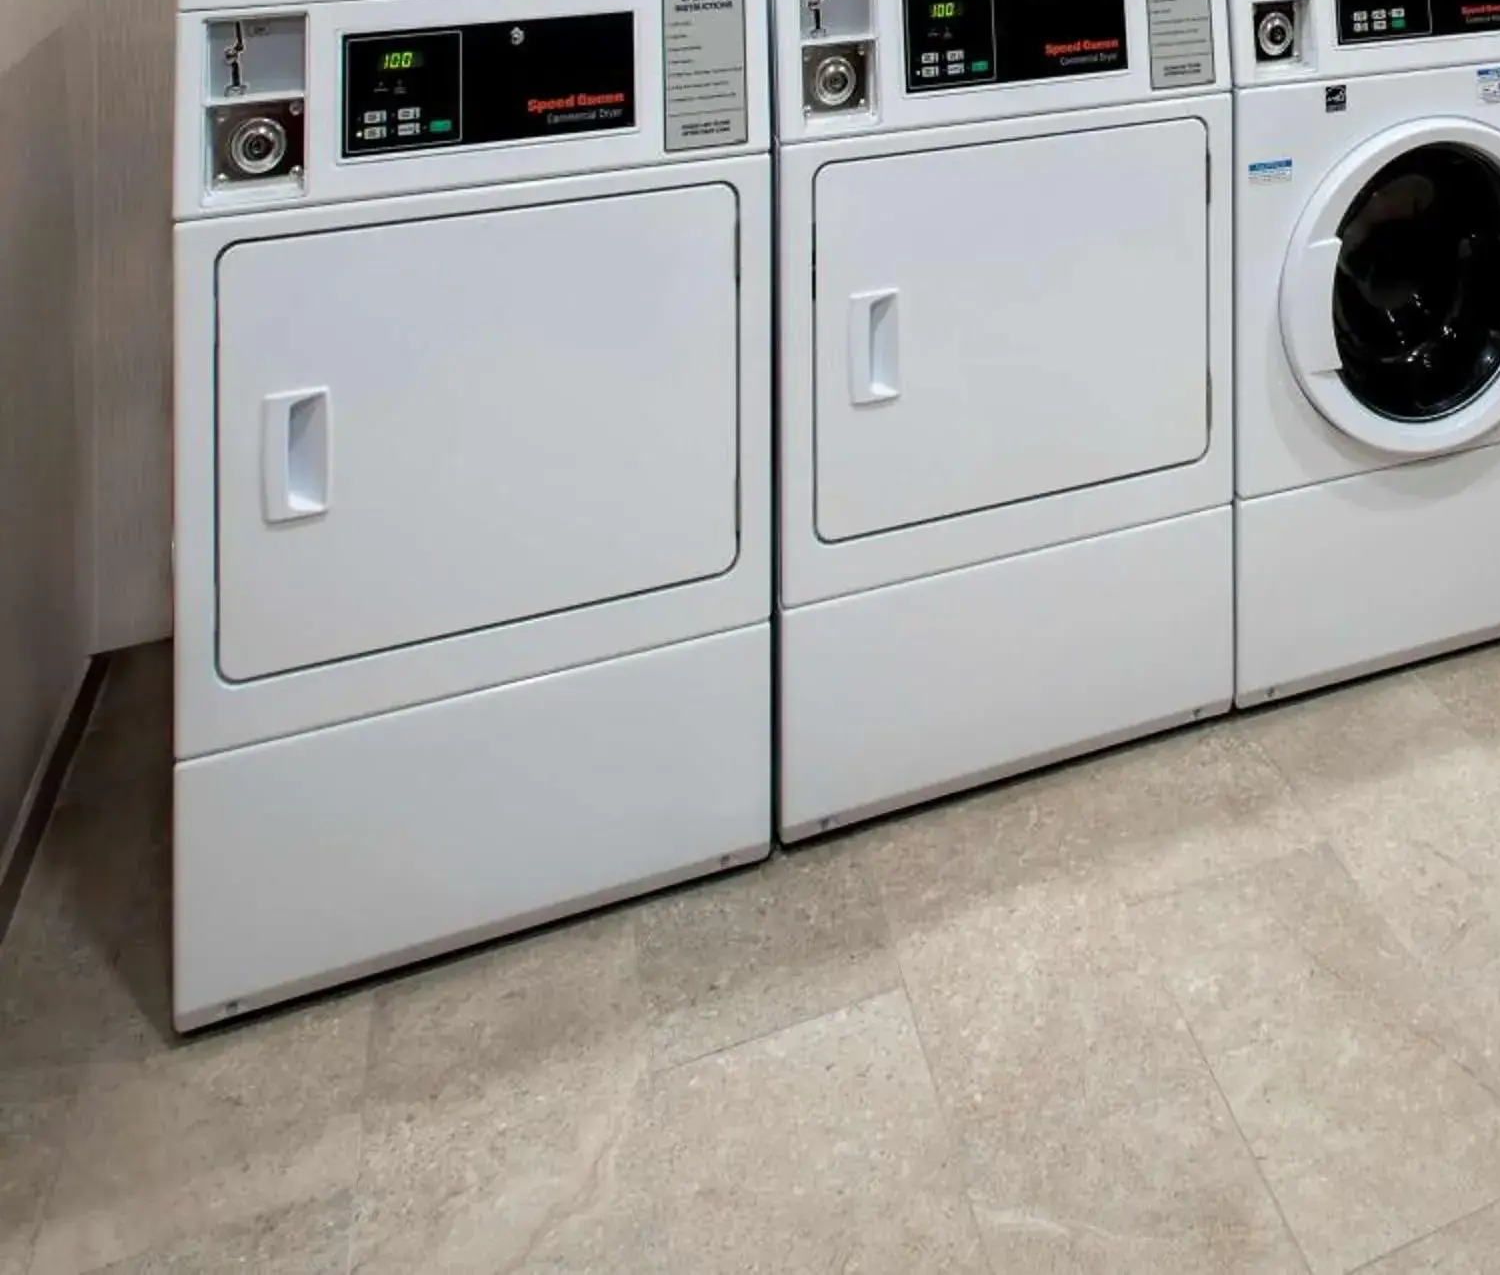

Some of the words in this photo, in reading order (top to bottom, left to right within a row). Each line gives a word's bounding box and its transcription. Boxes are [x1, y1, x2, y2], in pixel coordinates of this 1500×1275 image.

[932, 2, 956, 18] 100
[1044, 41, 1081, 57] Speed
[1083, 39, 1119, 51] Queen
[383, 51, 414, 70] 100
[527, 94, 575, 113] Speed
[577, 92, 625, 106] Queen
[546, 110, 597, 124] Commercial
[599, 108, 623, 119] Dryer
